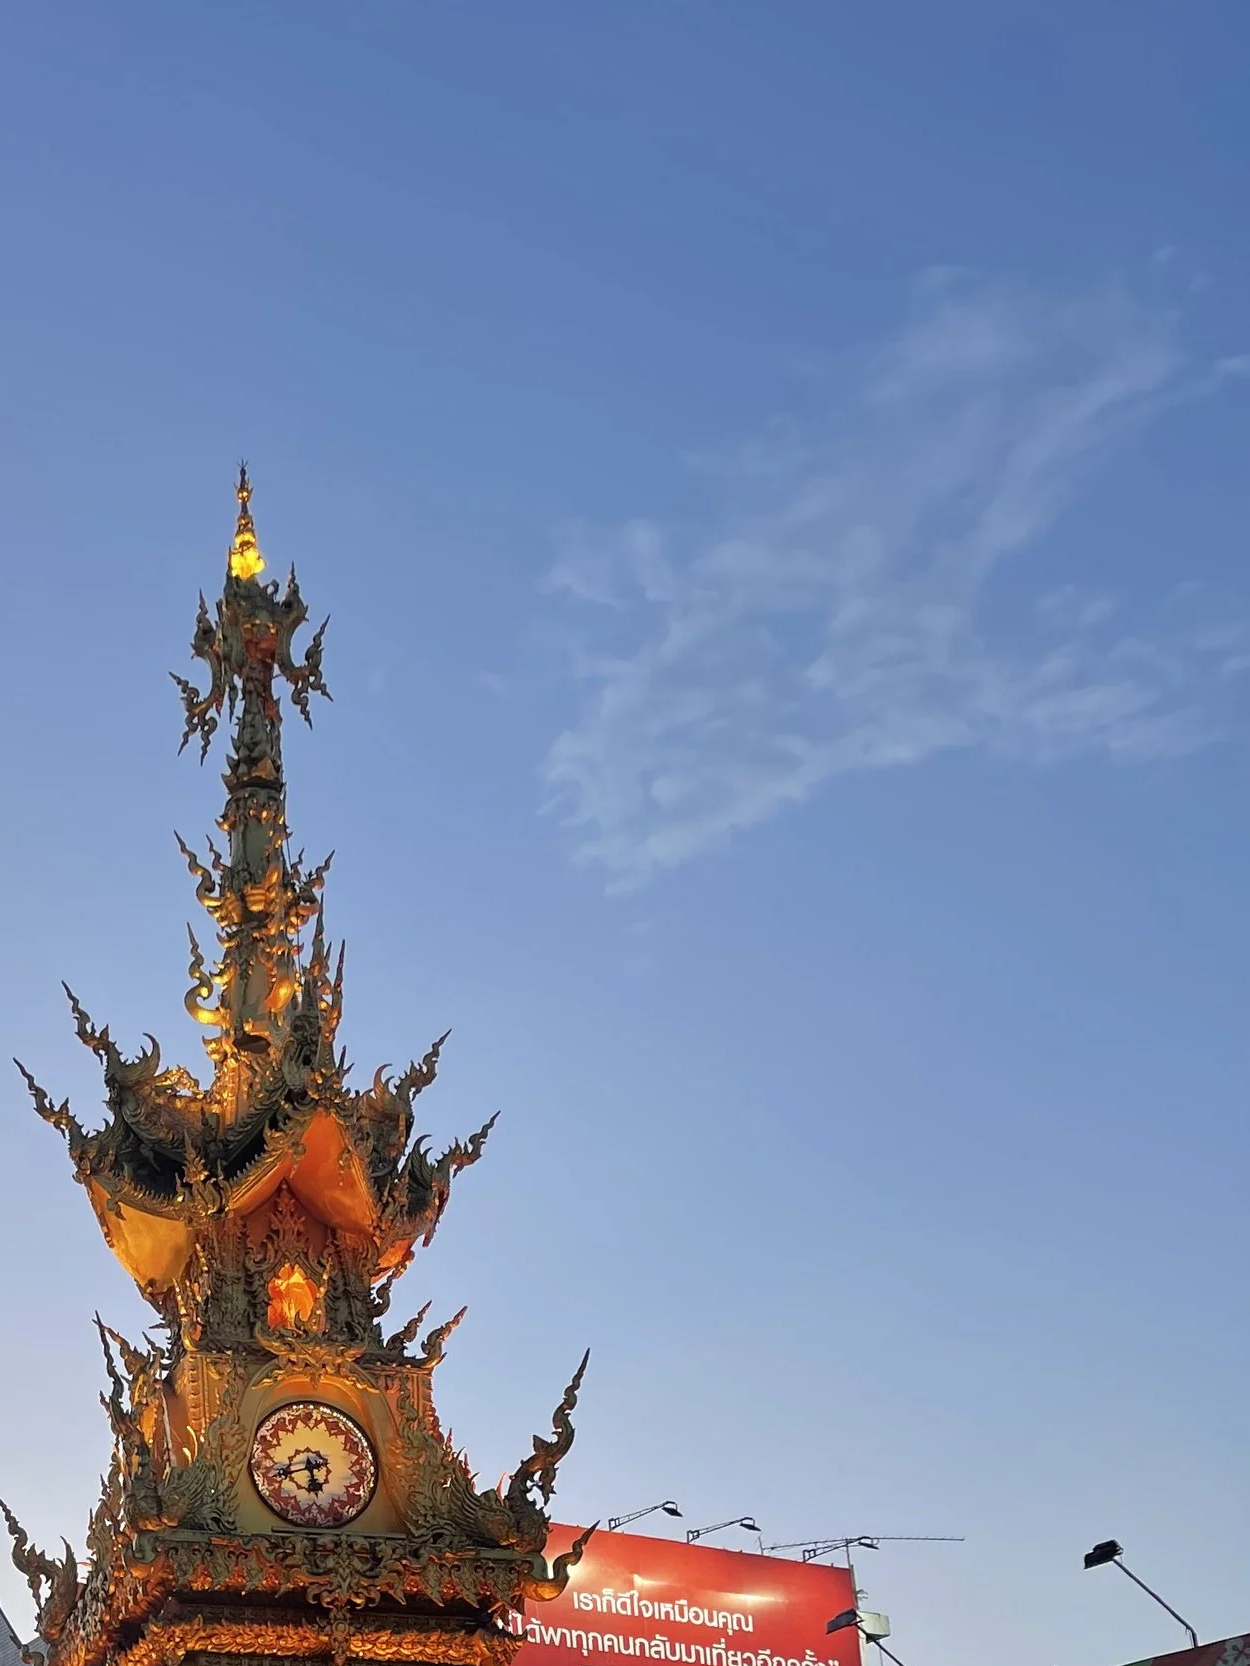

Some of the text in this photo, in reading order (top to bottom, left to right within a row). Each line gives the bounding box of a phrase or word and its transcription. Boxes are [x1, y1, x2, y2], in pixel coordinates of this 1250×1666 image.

[573, 1588, 754, 1635] เราก็ดีใจเหมือนคุณ
